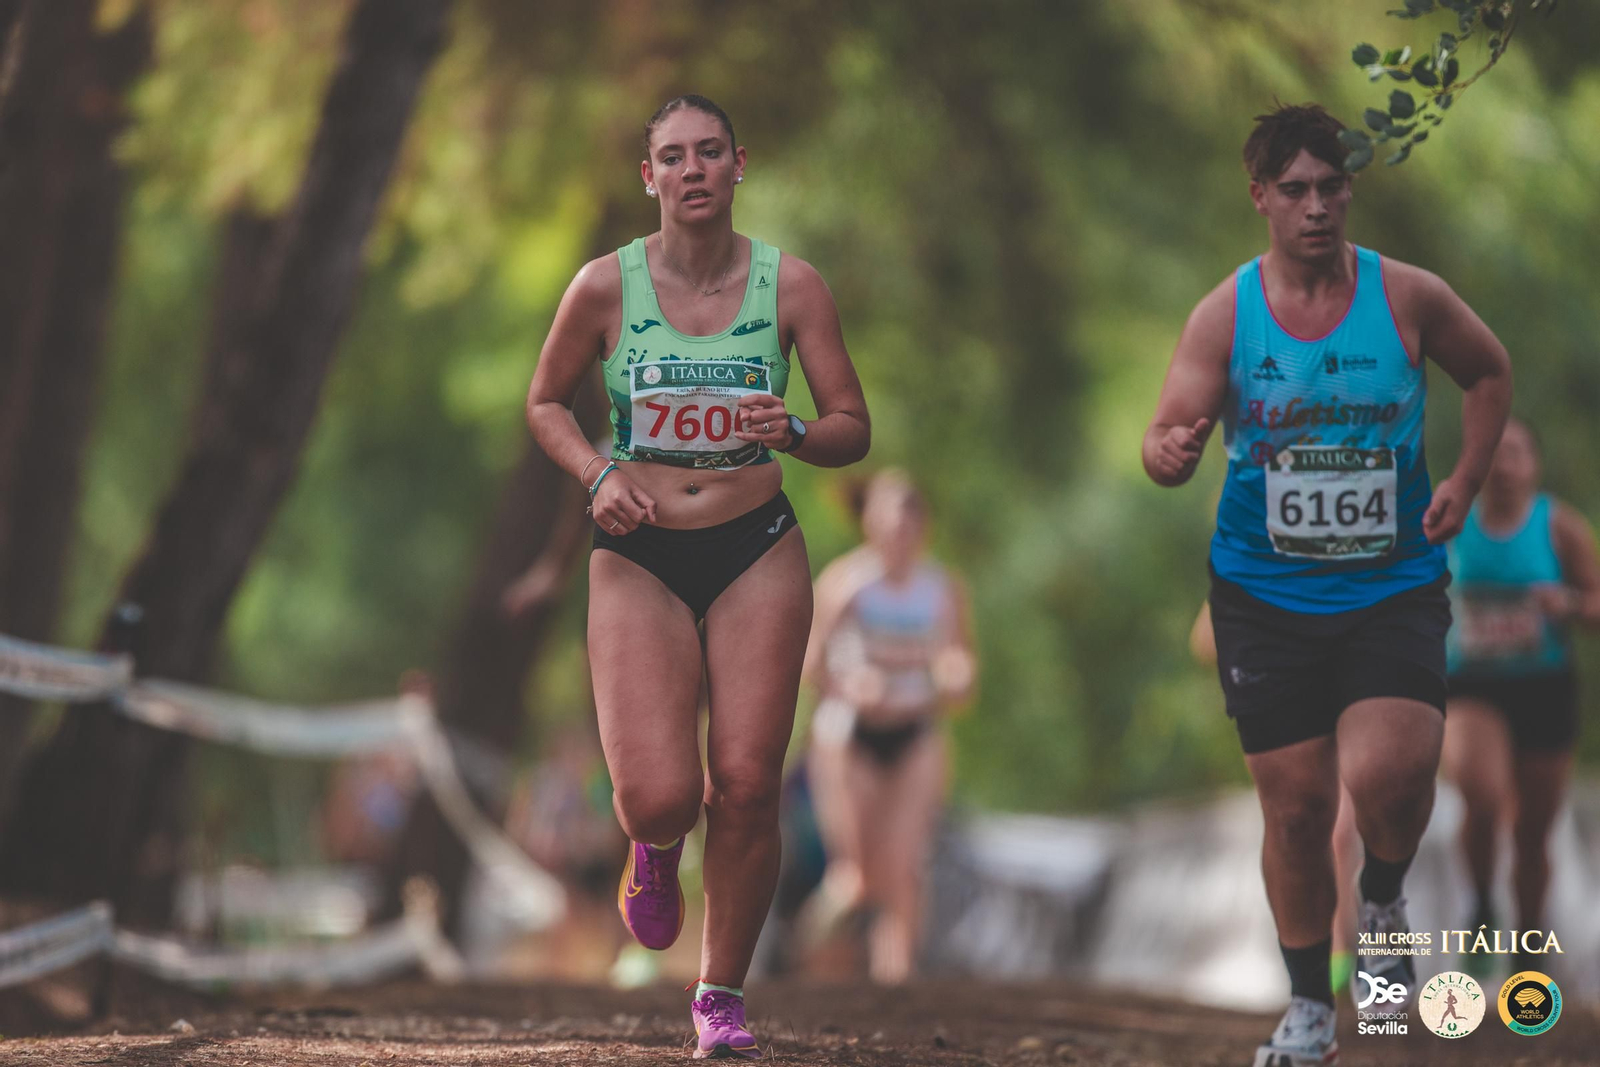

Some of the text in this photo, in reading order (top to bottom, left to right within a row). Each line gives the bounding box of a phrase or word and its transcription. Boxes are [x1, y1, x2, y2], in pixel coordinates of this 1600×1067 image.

[671, 364, 736, 379] ITÁLICA
[1241, 394, 1399, 430] Atletismo
[1279, 489, 1388, 526] 6164
